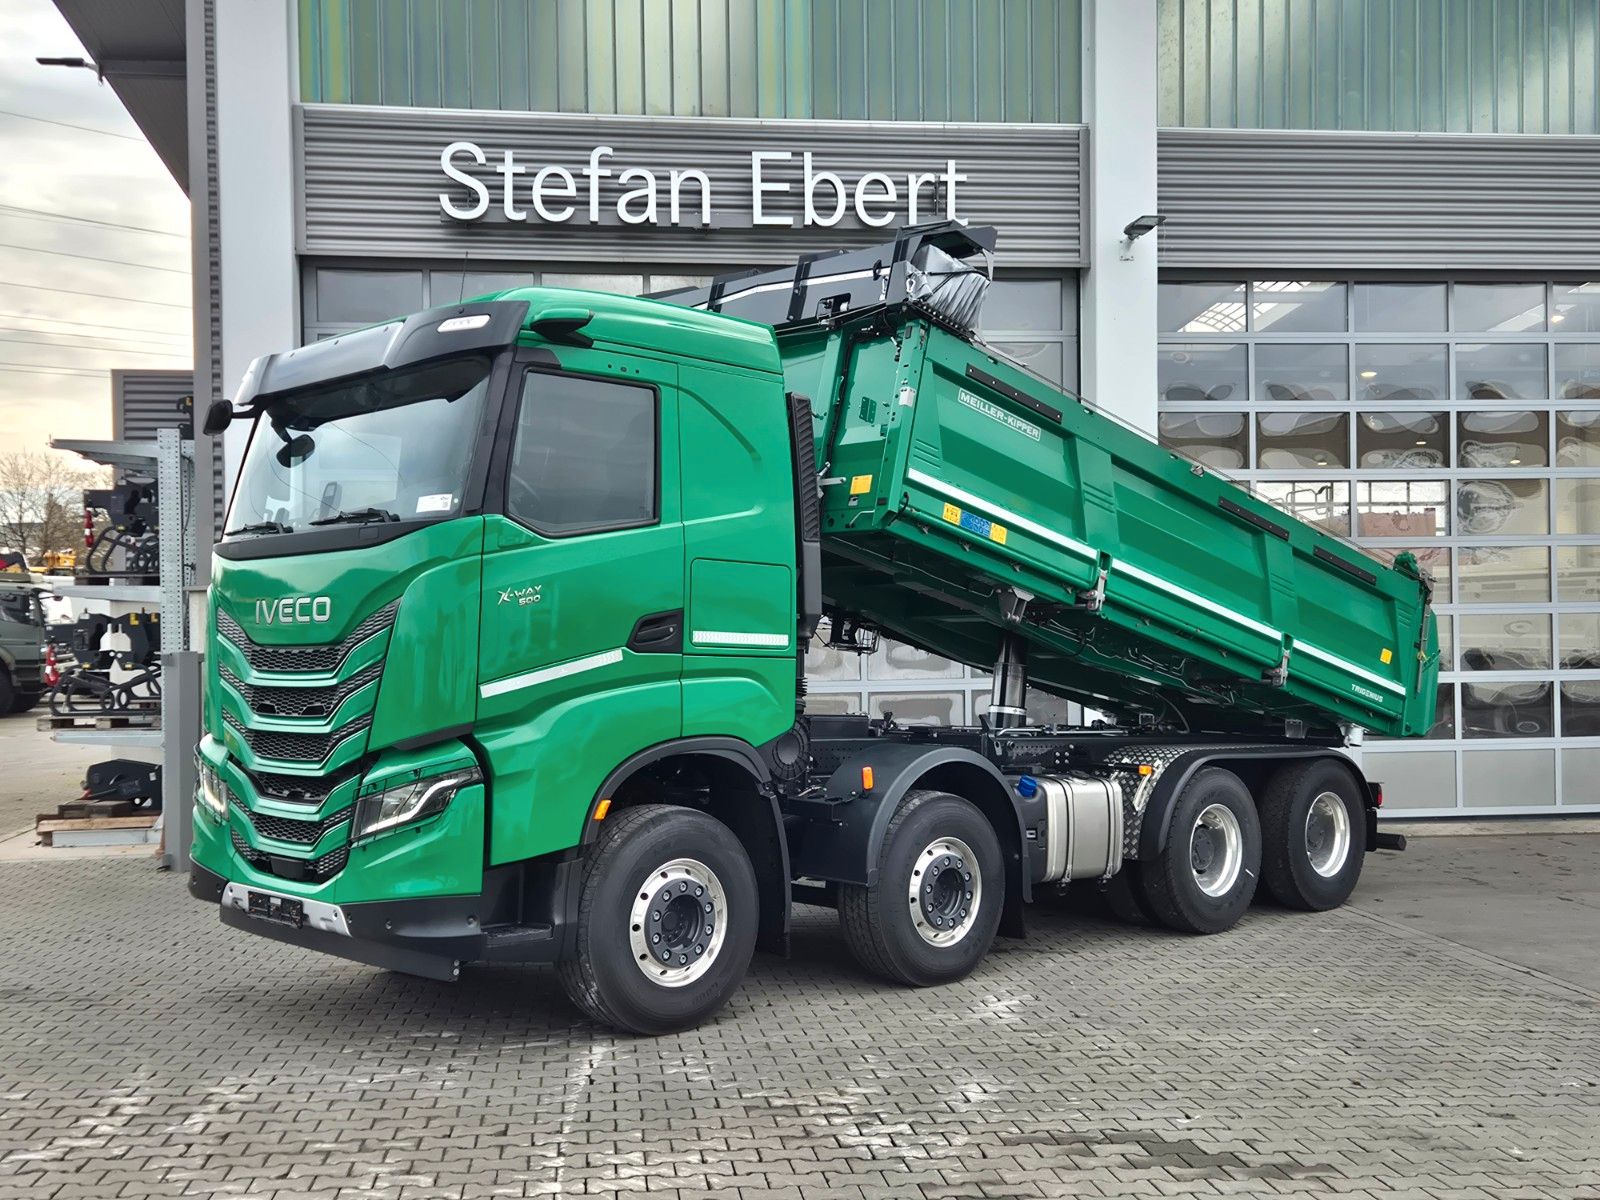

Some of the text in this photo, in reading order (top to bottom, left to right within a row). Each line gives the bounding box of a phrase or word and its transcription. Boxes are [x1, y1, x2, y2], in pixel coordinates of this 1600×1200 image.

[439, 141, 969, 227] Stefan Ebert
[960, 391, 1039, 438] MEILLER-KIPPER
[497, 584, 542, 605] X-WAY
[518, 594, 541, 606] 500
[255, 596, 331, 624] IVECO
